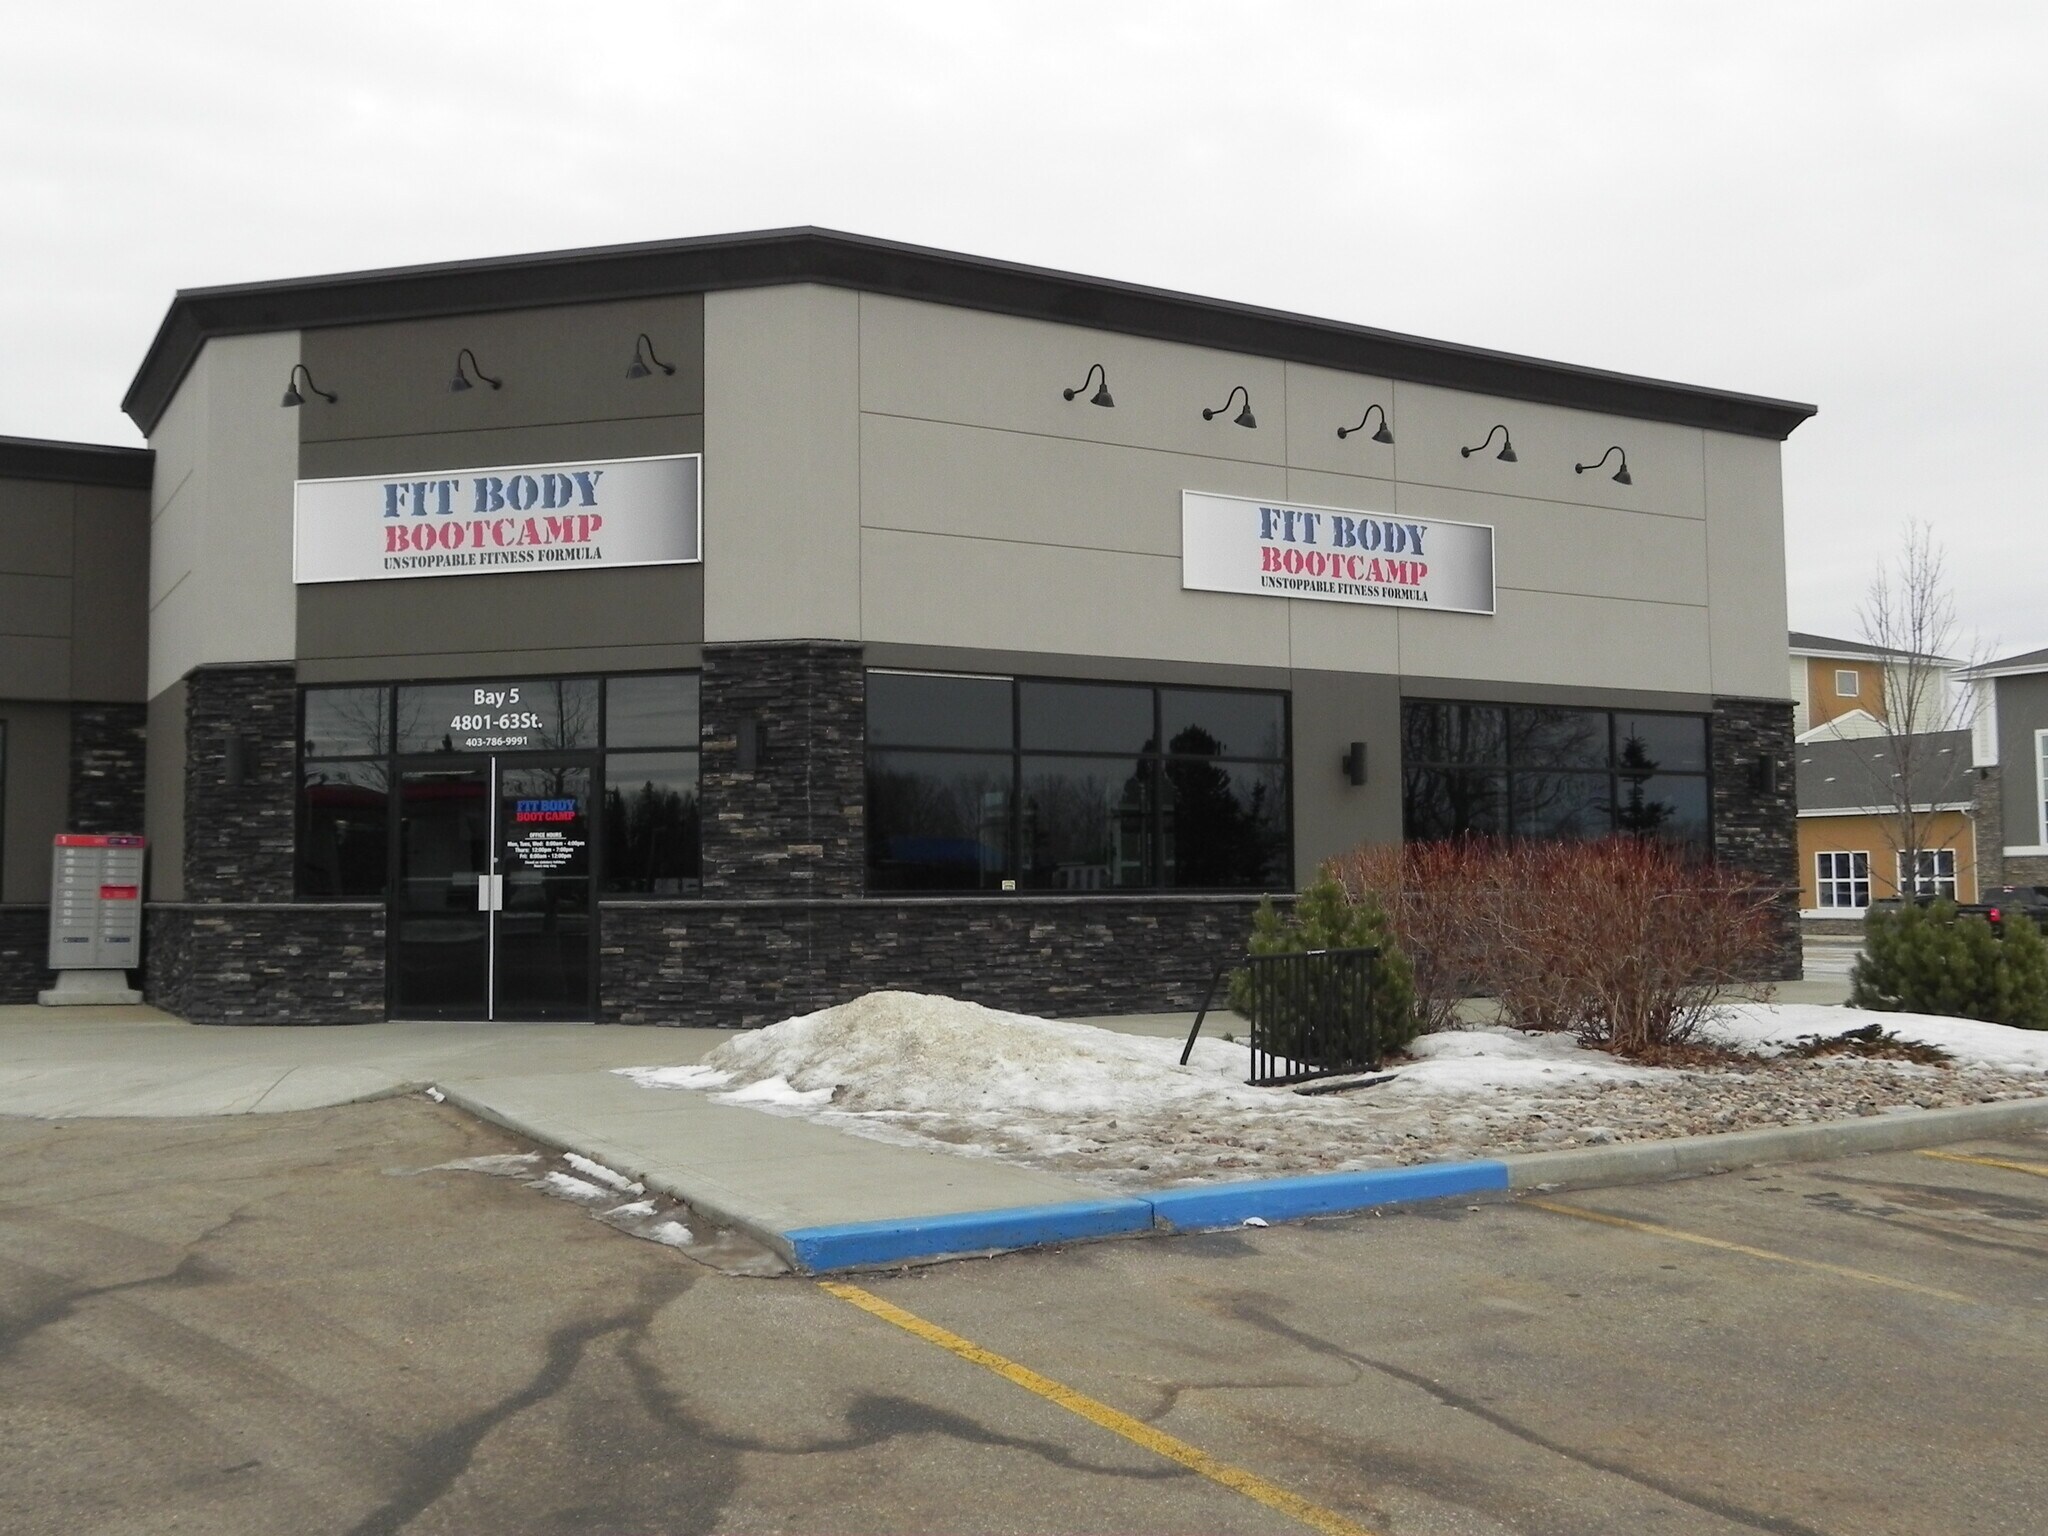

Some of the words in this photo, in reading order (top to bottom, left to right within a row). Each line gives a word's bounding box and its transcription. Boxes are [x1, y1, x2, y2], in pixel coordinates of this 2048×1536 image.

[383, 479, 459, 518] FIT
[473, 470, 604, 513] BODY
[384, 513, 603, 553] BOOTCAMP
[1259, 507, 1321, 544] FIT
[1331, 515, 1428, 556] BODY
[384, 552, 477, 570] UNSTOPPABLE
[479, 549, 535, 565] FITNESS
[538, 546, 602, 562] FORMULA
[1261, 546, 1428, 586] BOOTCAMP
[1261, 576, 1336, 594] UNSTOPPABLE
[1338, 582, 1380, 597] FITNESS
[1382, 586, 1428, 602] FORMULA
[474, 688, 506, 708] Bay
[509, 687, 520, 704] 5
[450, 712, 543, 731] 4801-63St.
[465, 736, 528, 747] 403-786-9991
[516, 800, 540, 812] FIT
[541, 799, 576, 812] BODY
